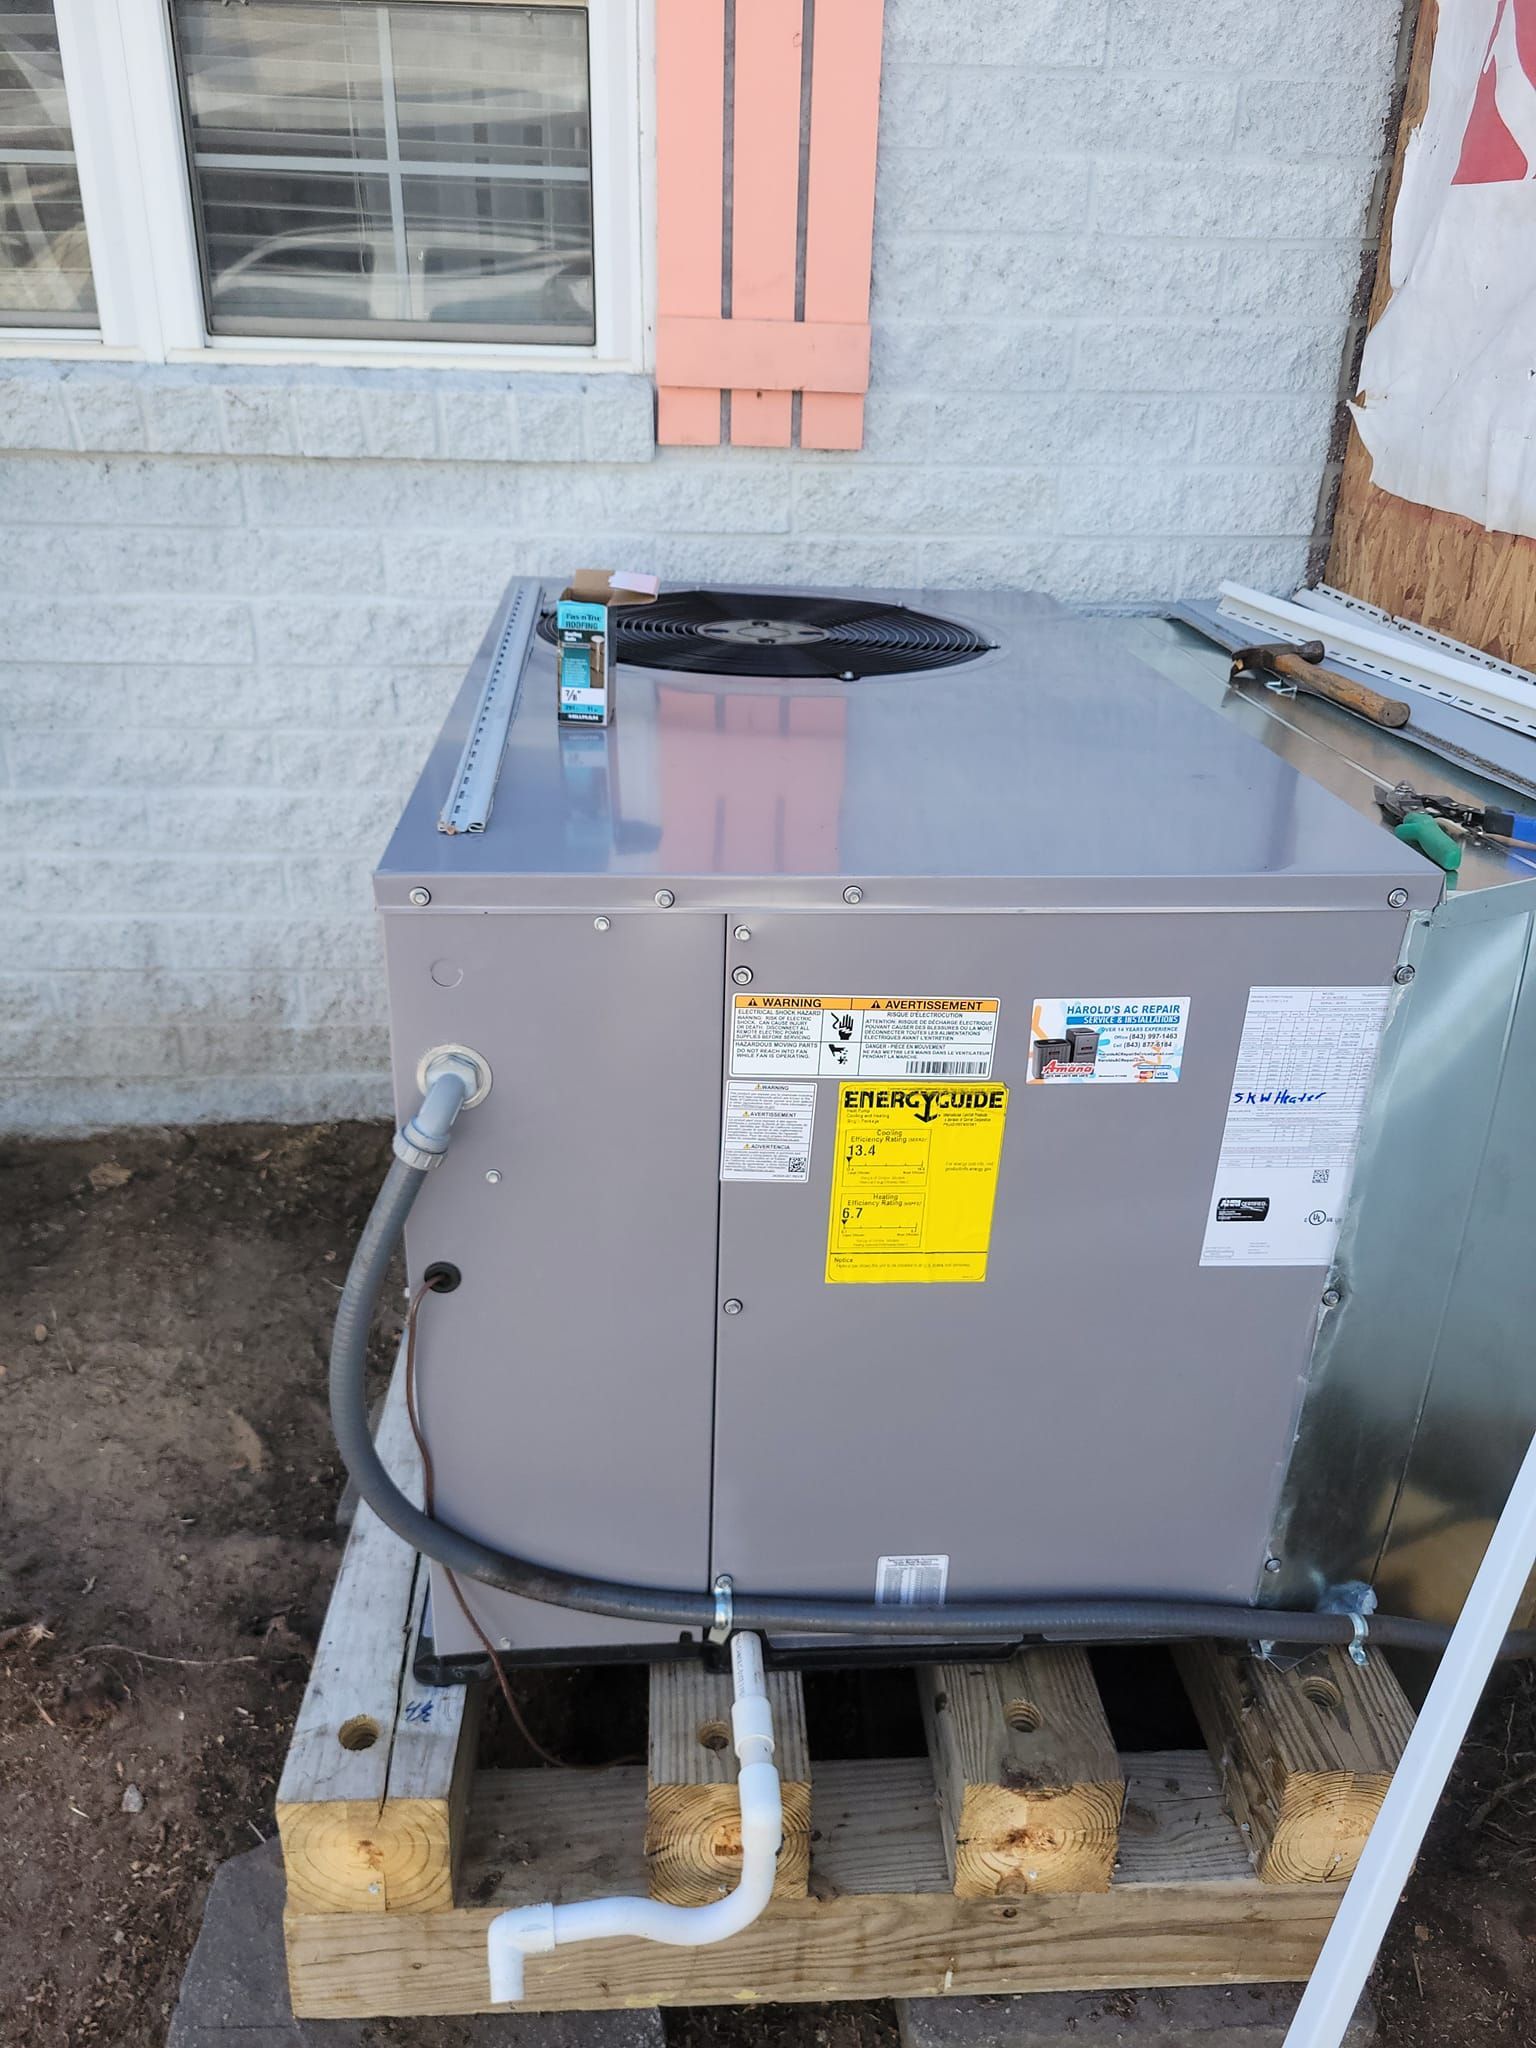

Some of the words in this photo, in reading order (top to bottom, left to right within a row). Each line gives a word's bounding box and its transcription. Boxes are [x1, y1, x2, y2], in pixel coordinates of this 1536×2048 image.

[566, 621, 598, 629] ROOFING
[762, 998, 821, 1007] WARNING
[886, 1001, 983, 1010] AVERTISSEMENT
[1067, 1006, 1120, 1014] HAROLD'S
[1124, 1005, 1138, 1014] AC
[1142, 1005, 1180, 1013] REPAIR
[1084, 1016, 1114, 1024] SERVICE
[1125, 1015, 1178, 1023] INSTALLATIONS
[1044, 1060, 1093, 1072] Amana
[1274, 1089, 1326, 1104] Heater
[848, 1144, 875, 1156] 13.4
[842, 1208, 863, 1218] 6.7
